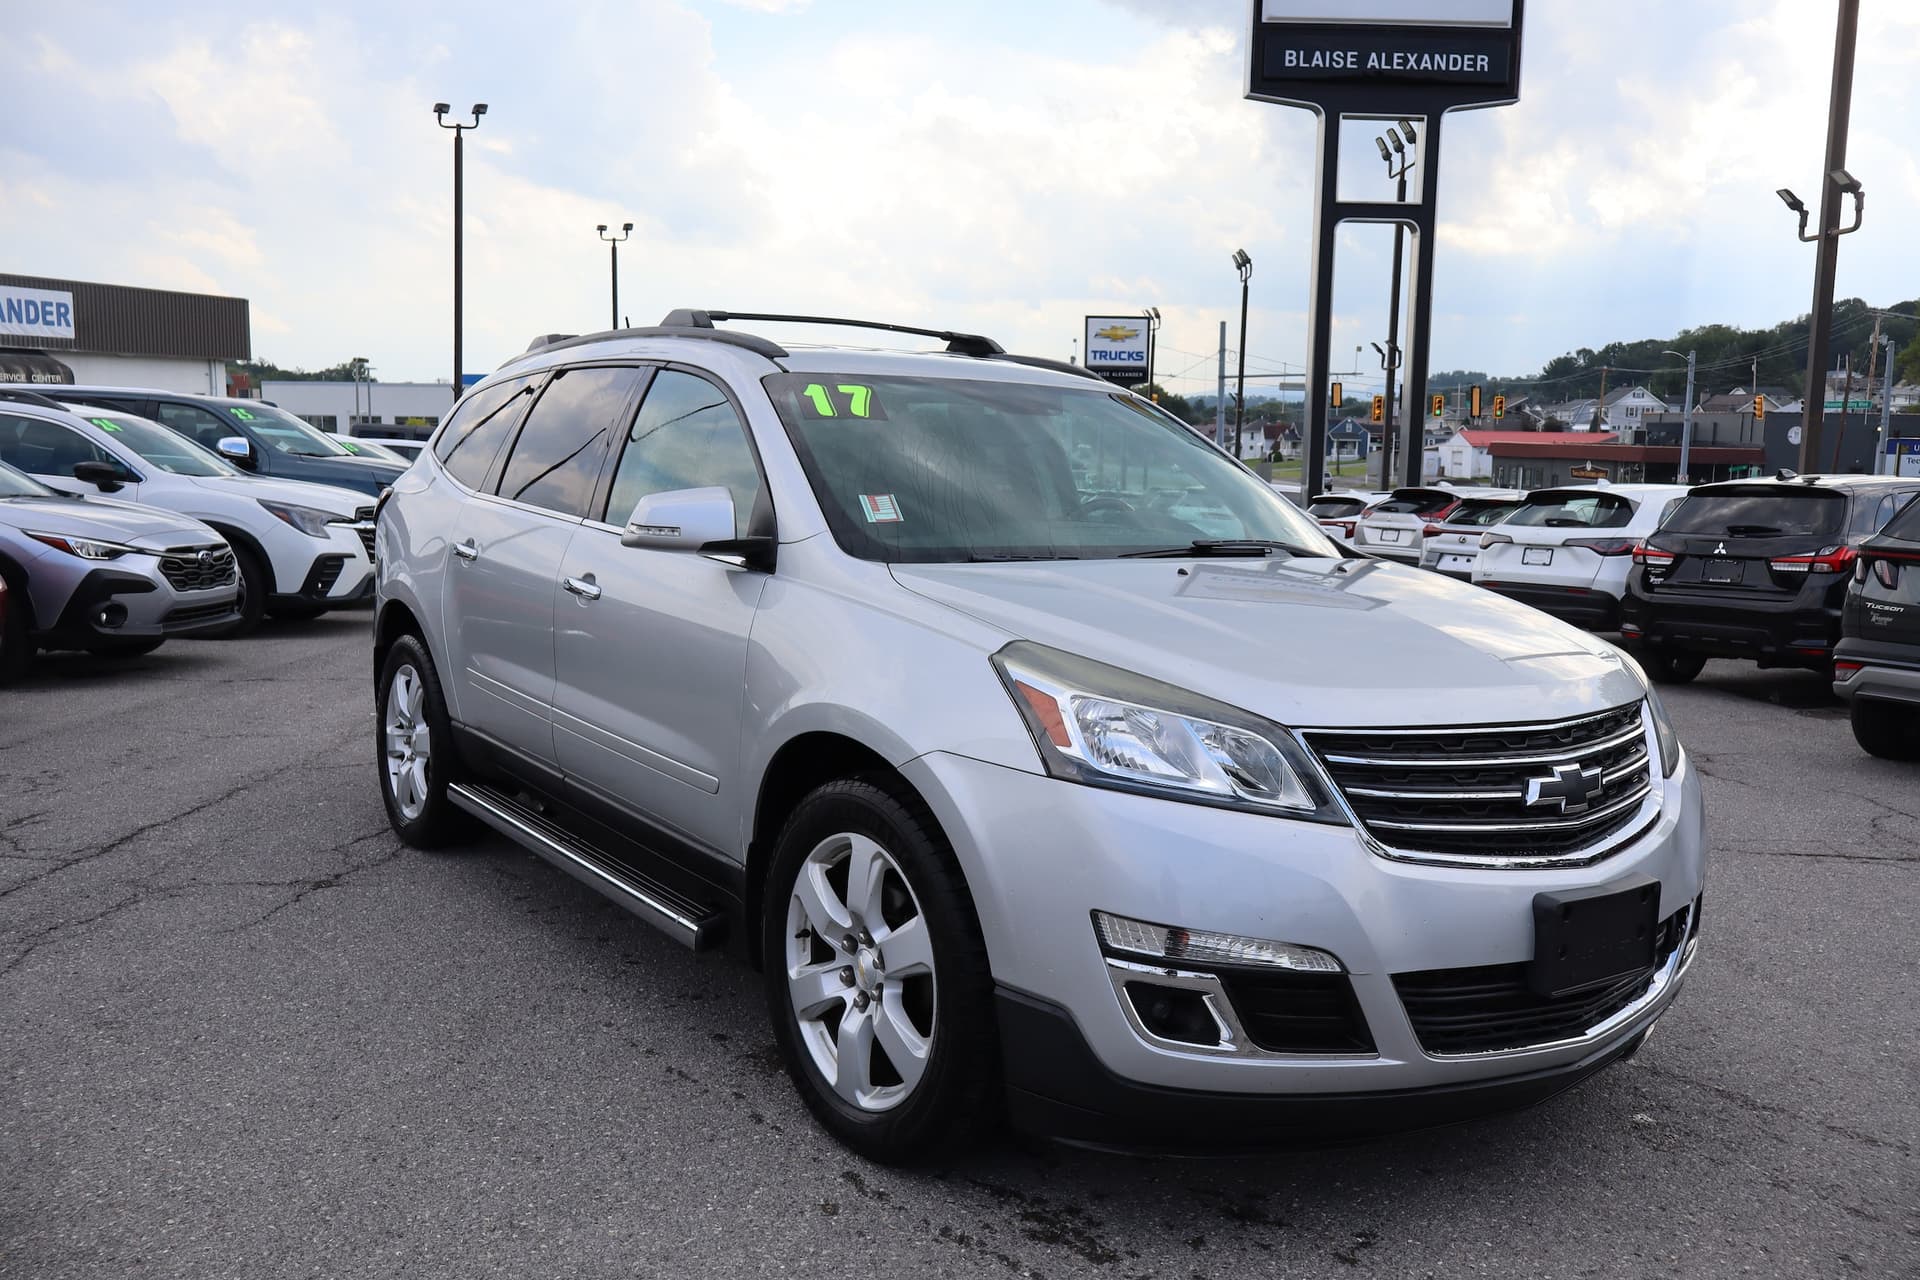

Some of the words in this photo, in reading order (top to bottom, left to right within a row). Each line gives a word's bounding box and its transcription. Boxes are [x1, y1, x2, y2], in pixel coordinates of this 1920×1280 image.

[1284, 50, 1358, 68] BLAISE
[1367, 52, 1489, 72] ALEXANDER
[1091, 350, 1144, 361] TRUCKS
[31, 374, 62, 383] CENTER
[803, 384, 872, 418] 17
[1865, 602, 1904, 612] Tucson
